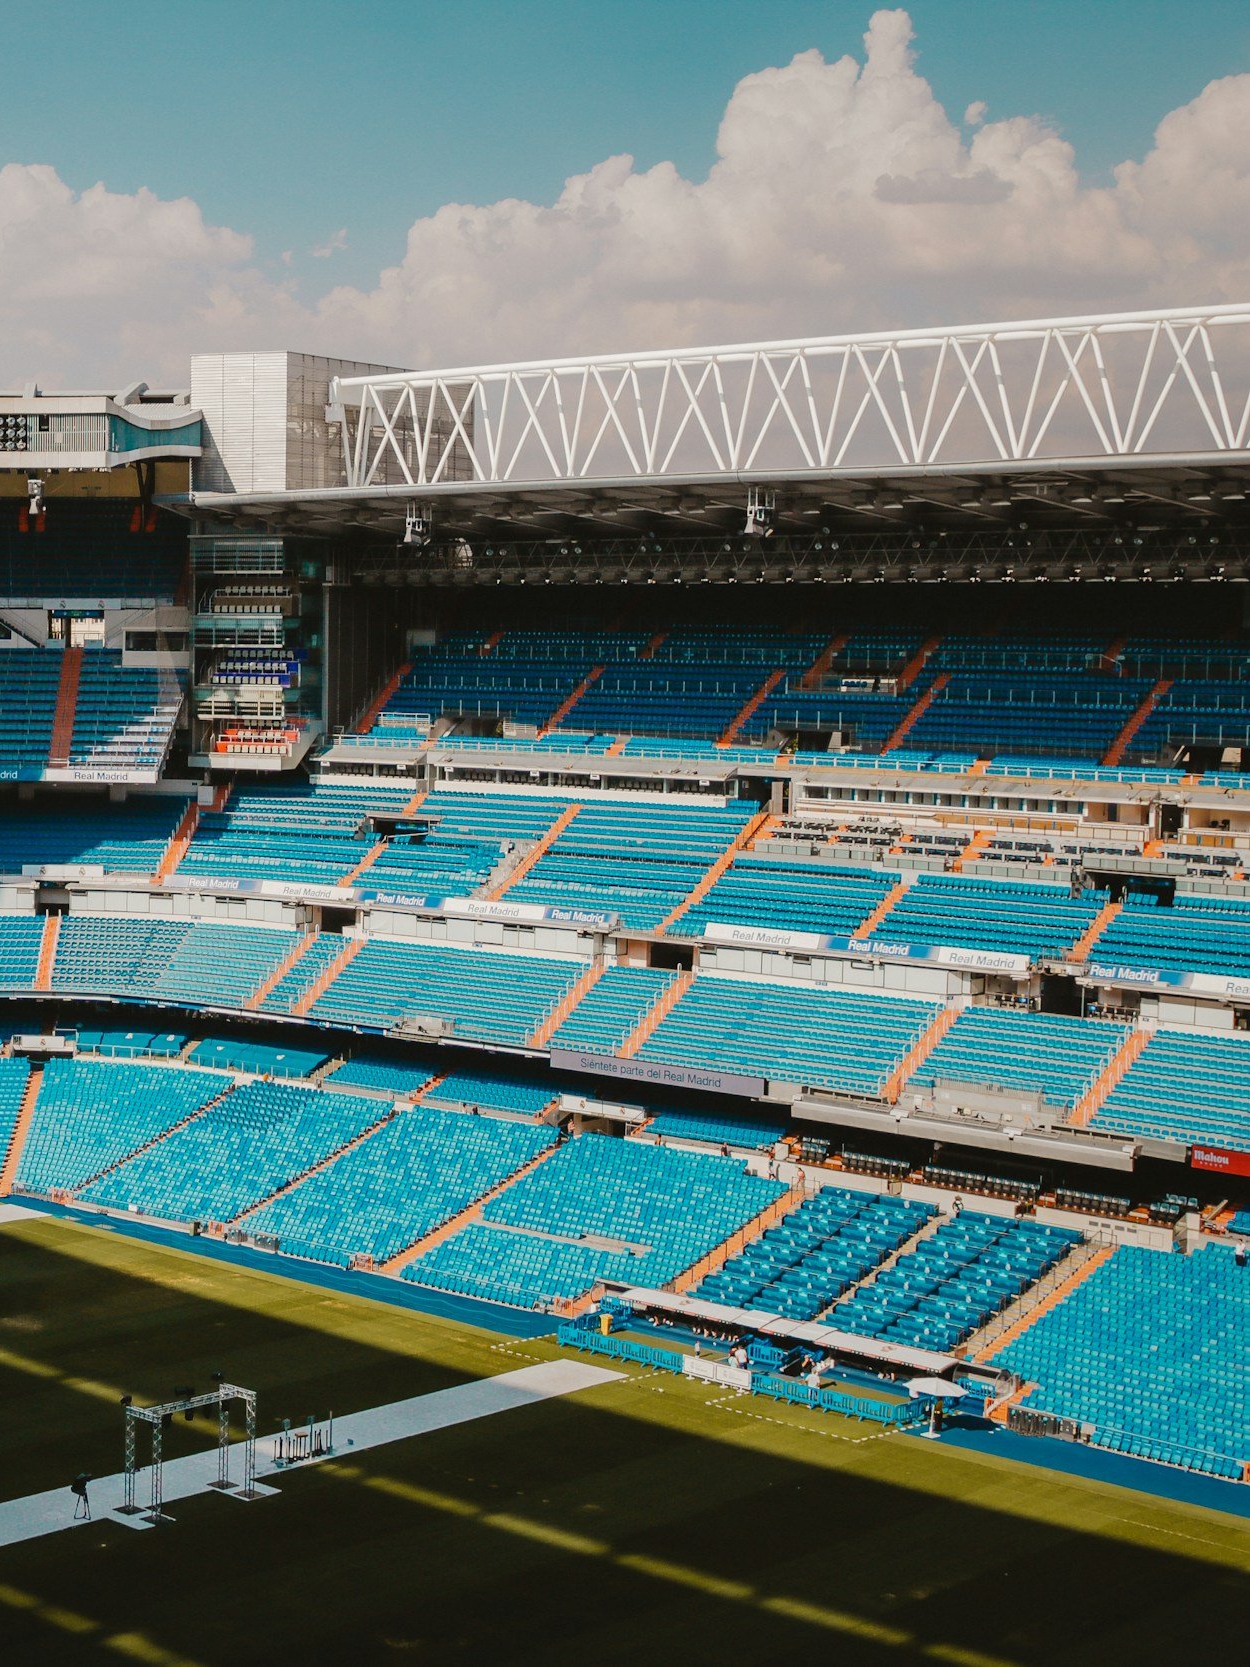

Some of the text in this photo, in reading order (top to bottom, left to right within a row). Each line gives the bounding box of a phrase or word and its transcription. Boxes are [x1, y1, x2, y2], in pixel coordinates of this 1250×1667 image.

[74, 771, 128, 782] Real Madrid
[189, 878, 239, 890] Real Madrid
[283, 886, 331, 899] Real Madrid
[376, 893, 424, 907] Real Madrid
[468, 903, 519, 917] Real Madrid
[551, 909, 604, 923] Real Madrid
[732, 929, 791, 945] Real Madrid
[848, 940, 910, 956] Real Madrid
[949, 952, 1015, 969] Real Madrid
[1090, 965, 1159, 982] Real Madrid
[1226, 982, 1248, 993] Rea
[580, 1058, 721, 1088] Siéntete parte del Real Madrid
[1194, 1150, 1229, 1165] Mahou
